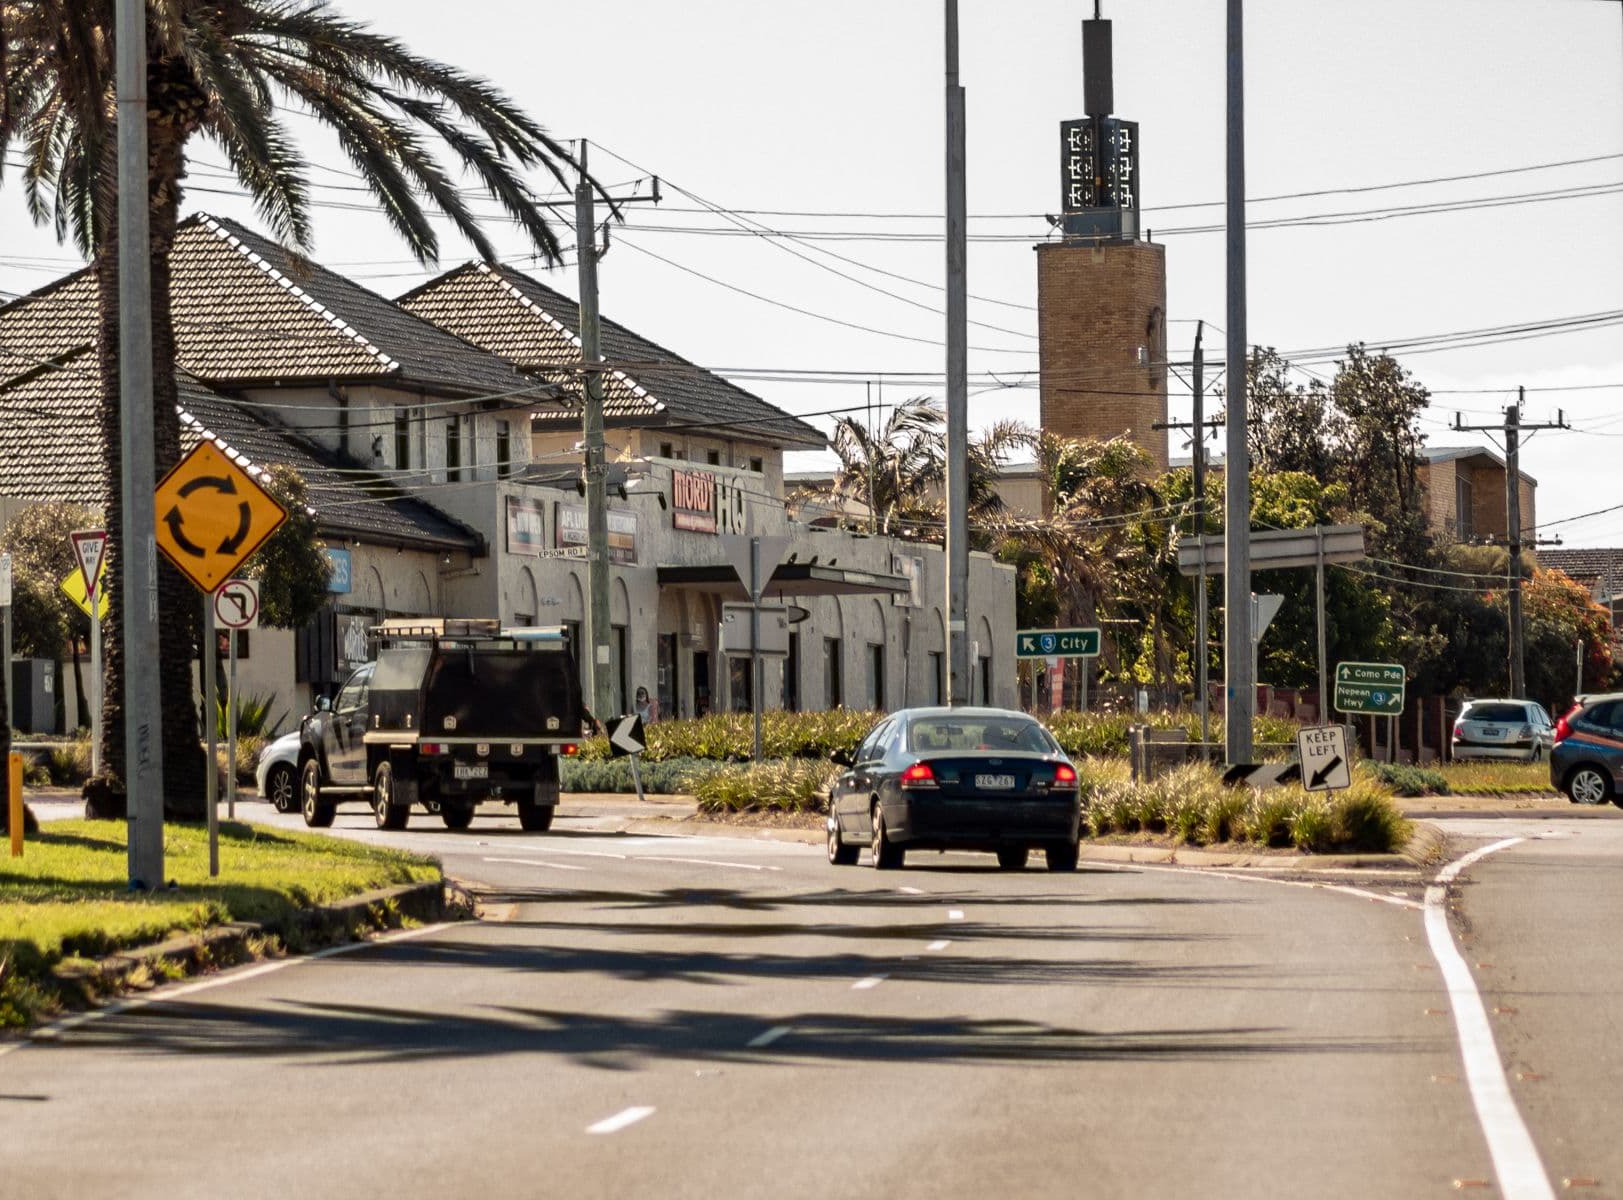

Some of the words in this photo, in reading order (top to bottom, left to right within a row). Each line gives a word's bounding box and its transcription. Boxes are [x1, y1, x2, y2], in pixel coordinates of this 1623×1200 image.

[717, 473, 747, 535] HQ
[82, 542, 99, 553] GIVE
[538, 550, 565, 559] EPSOM
[567, 548, 578, 556] RD
[1061, 637, 1088, 651] City
[1355, 669, 1381, 679] Como
[1384, 670, 1401, 680] Pde
[1338, 687, 1371, 697] Nepean
[1344, 699, 1364, 709] Hwy
[1305, 731, 1337, 744] KEEP
[1309, 744, 1337, 757] LEFT
